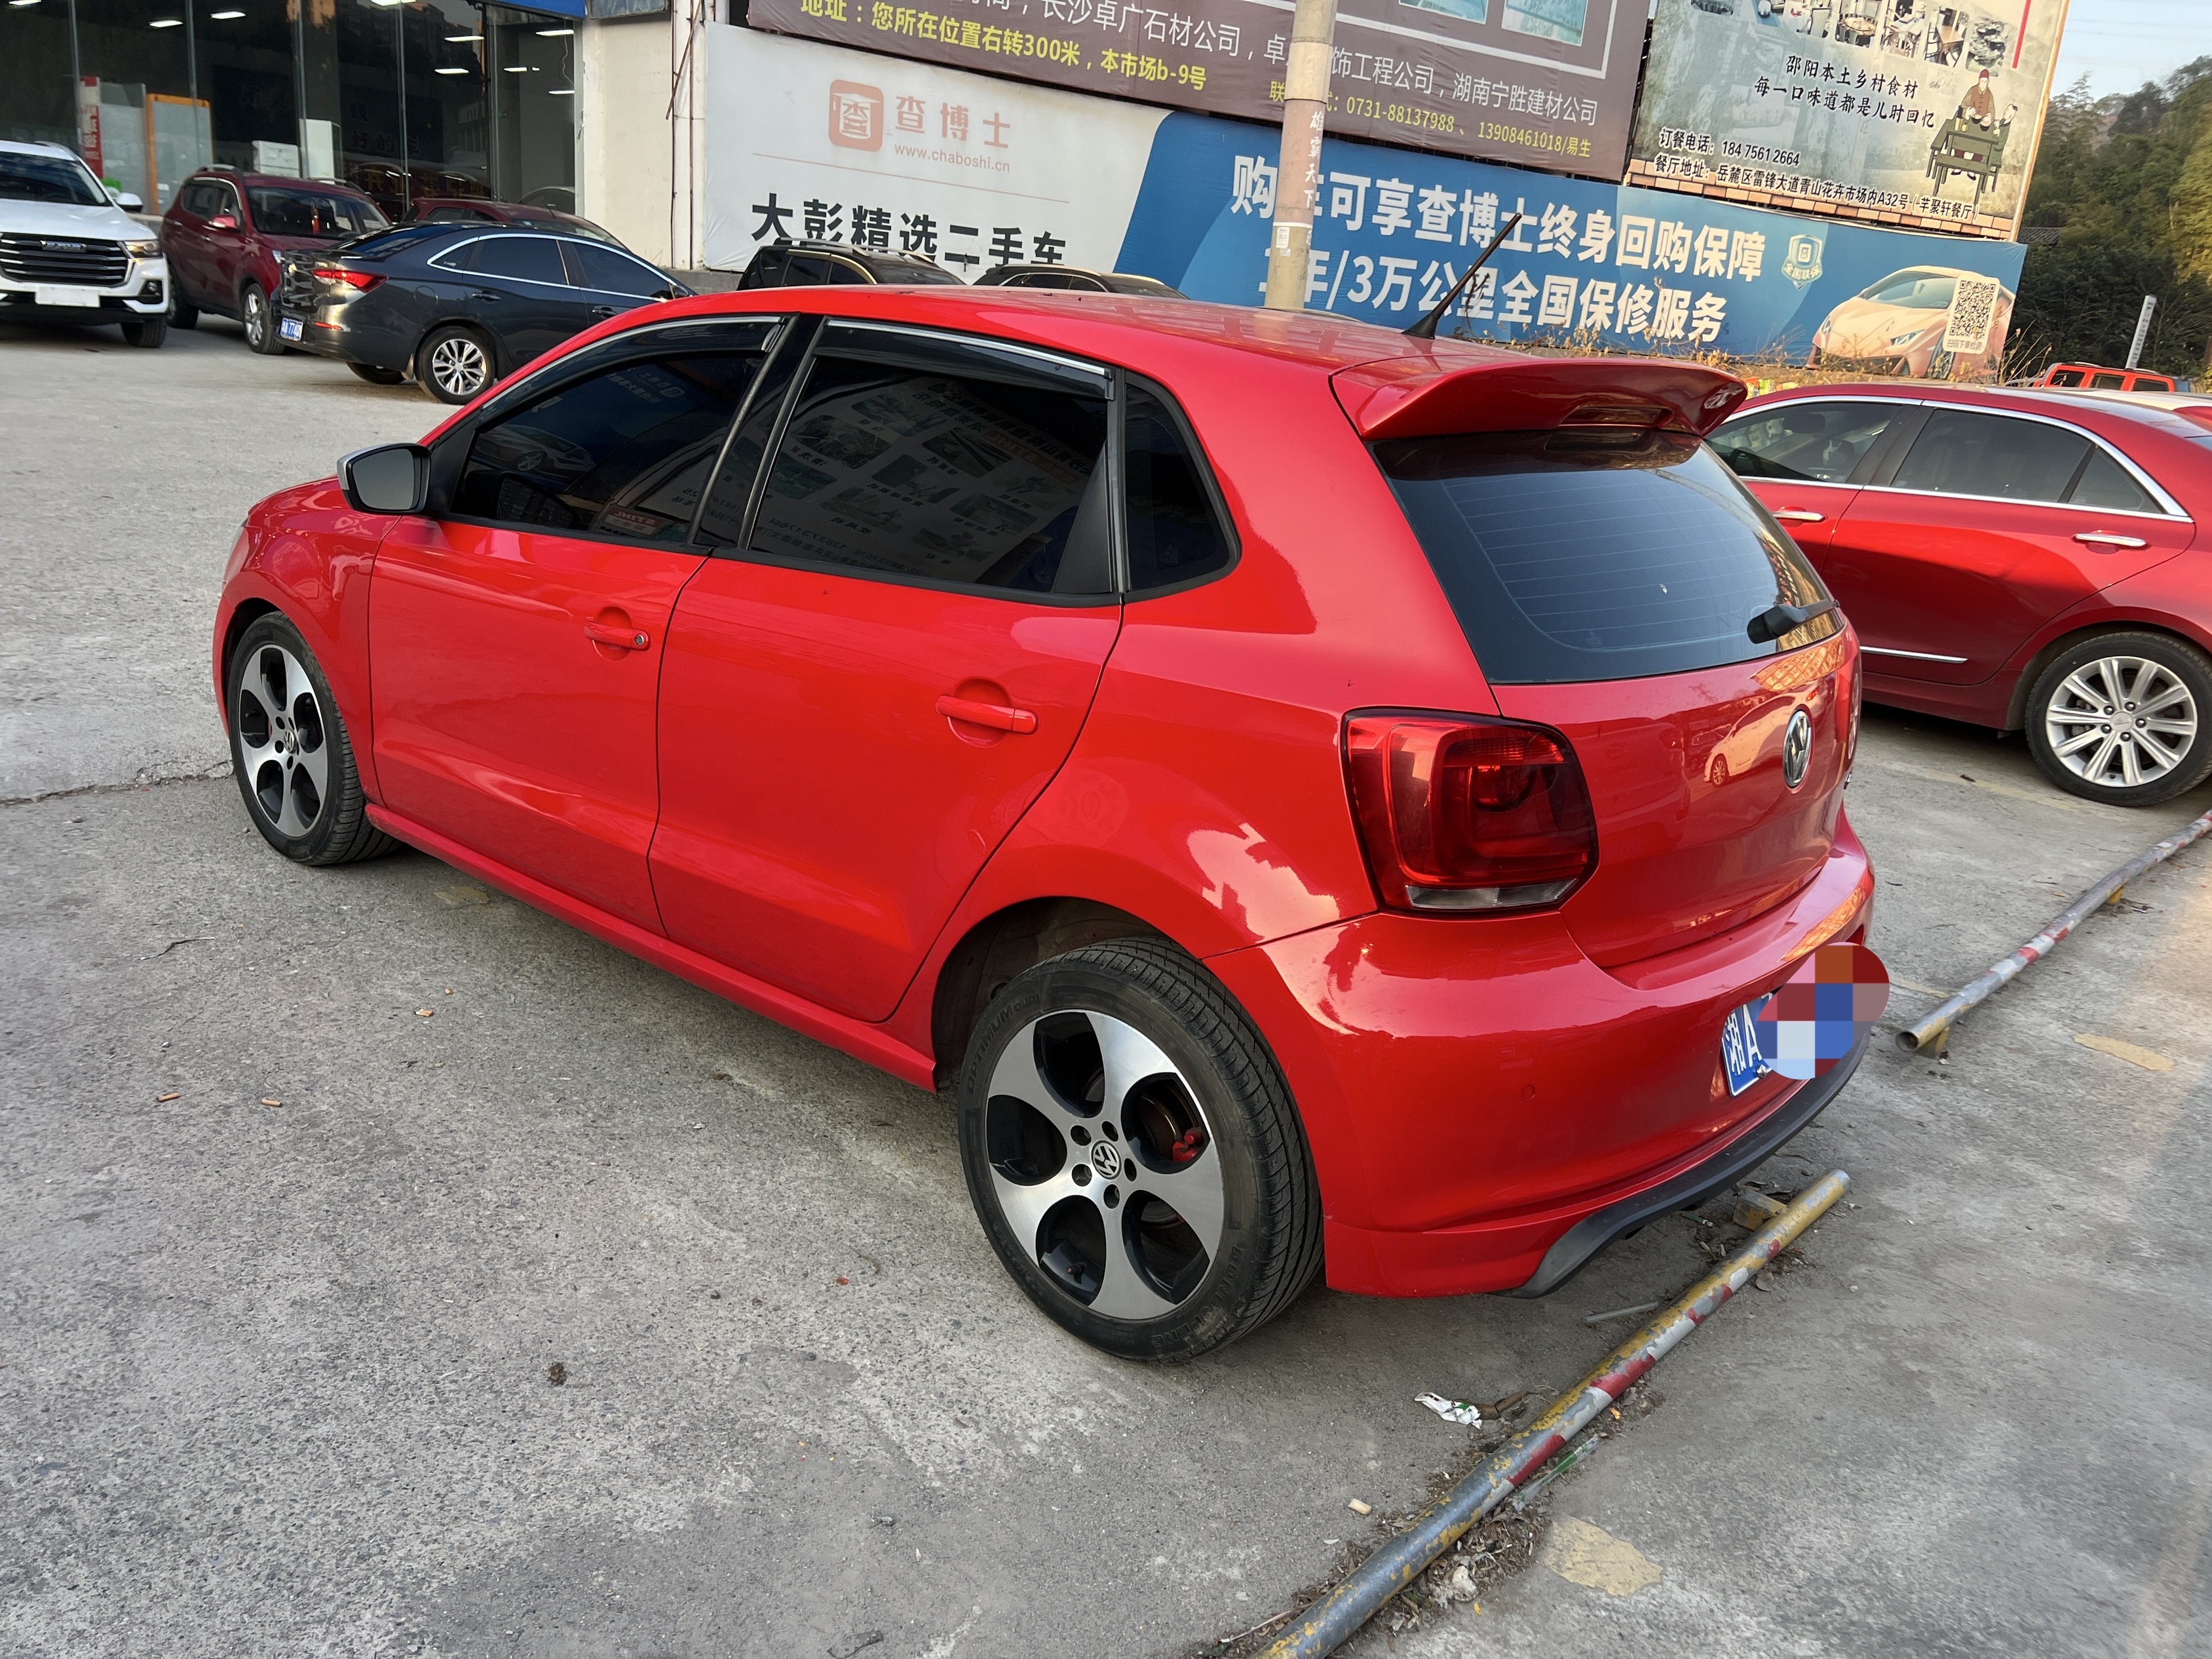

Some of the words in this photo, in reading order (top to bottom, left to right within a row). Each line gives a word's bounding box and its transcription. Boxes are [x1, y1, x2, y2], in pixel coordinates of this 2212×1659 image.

[1754, 75, 1935, 128] 每一口味道都是儿时回忆
[1785, 55, 1918, 100] 邵阳本土乡村食材
[895, 95, 1011, 149] 查博士
[894, 143, 1010, 172] www.chaboshi.cn
[751, 192, 1067, 266] 大彭精选二手车
[1230, 155, 1766, 282] 购可享查博士终身回购保障
[1258, 247, 1727, 343] 年/3万公里全国保修服务
